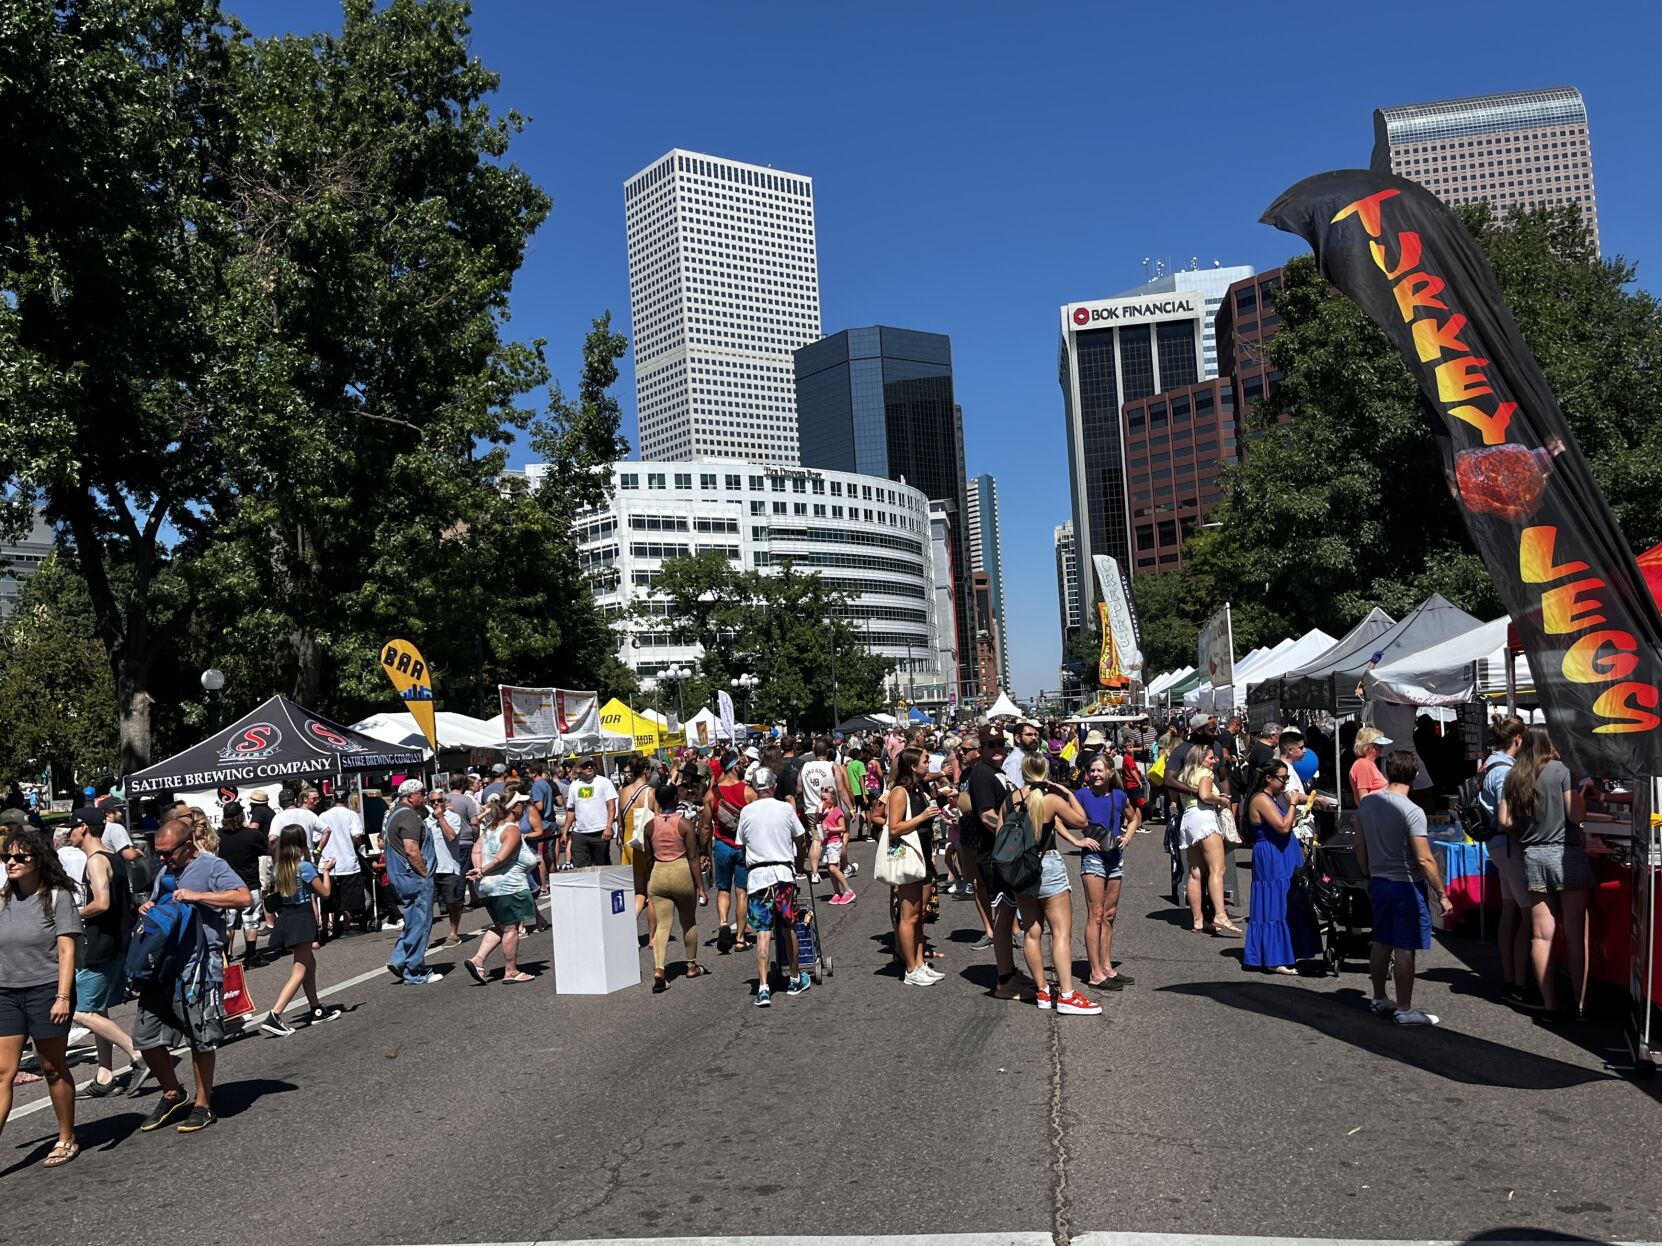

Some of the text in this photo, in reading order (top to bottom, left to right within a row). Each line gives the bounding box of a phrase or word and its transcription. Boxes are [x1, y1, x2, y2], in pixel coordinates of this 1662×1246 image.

[1091, 300, 1194, 322] BOK FINANCIAL
[1331, 189, 1518, 445] TURKEY
[1100, 558, 1130, 648] CREPES
[1519, 525, 1662, 734] LEGS
[383, 646, 424, 681] BAR
[131, 757, 332, 792] SATIRE BREWING COMPANY
